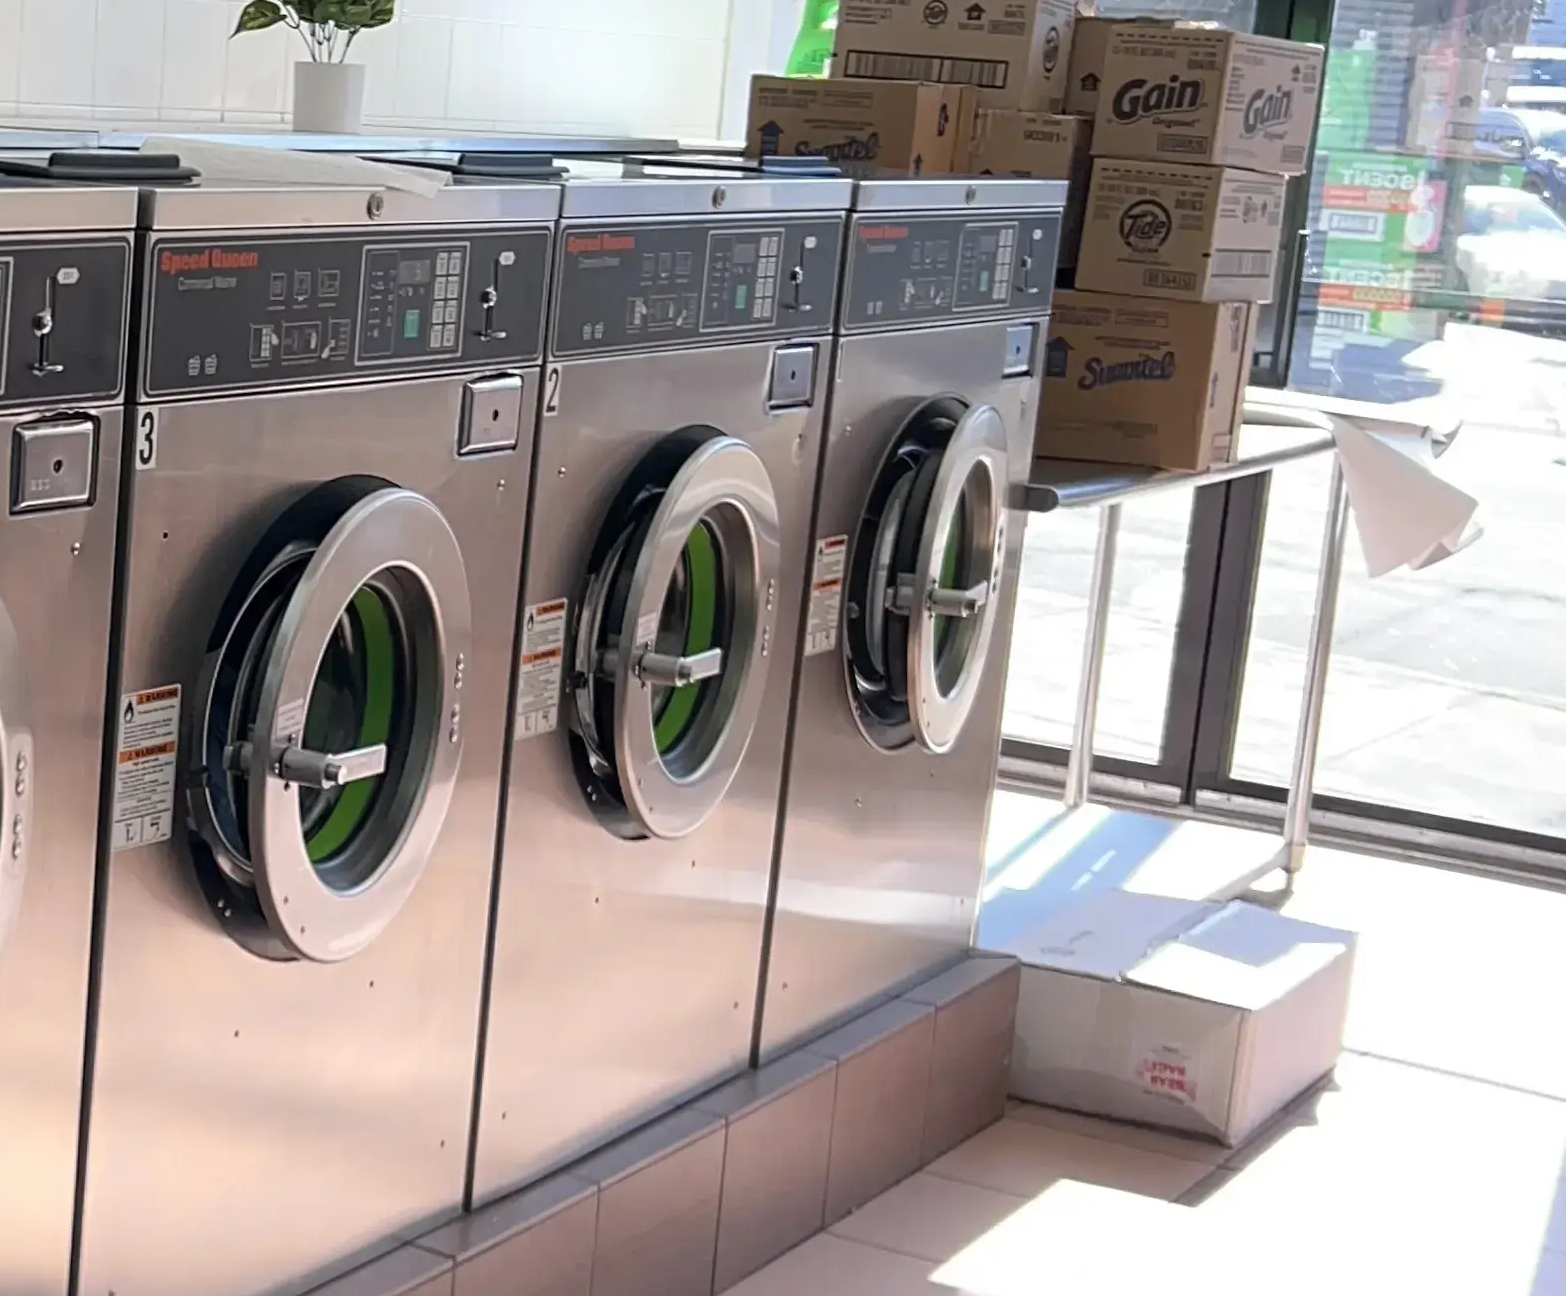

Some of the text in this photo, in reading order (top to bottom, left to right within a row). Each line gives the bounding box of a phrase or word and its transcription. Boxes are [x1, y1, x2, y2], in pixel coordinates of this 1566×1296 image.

[1112, 74, 1202, 121] Gain
[1244, 84, 1292, 134] Gain
[1123, 210, 1166, 241] Tide
[161, 249, 209, 275] Speed
[546, 368, 559, 413] 2
[139, 411, 155, 465] 3
